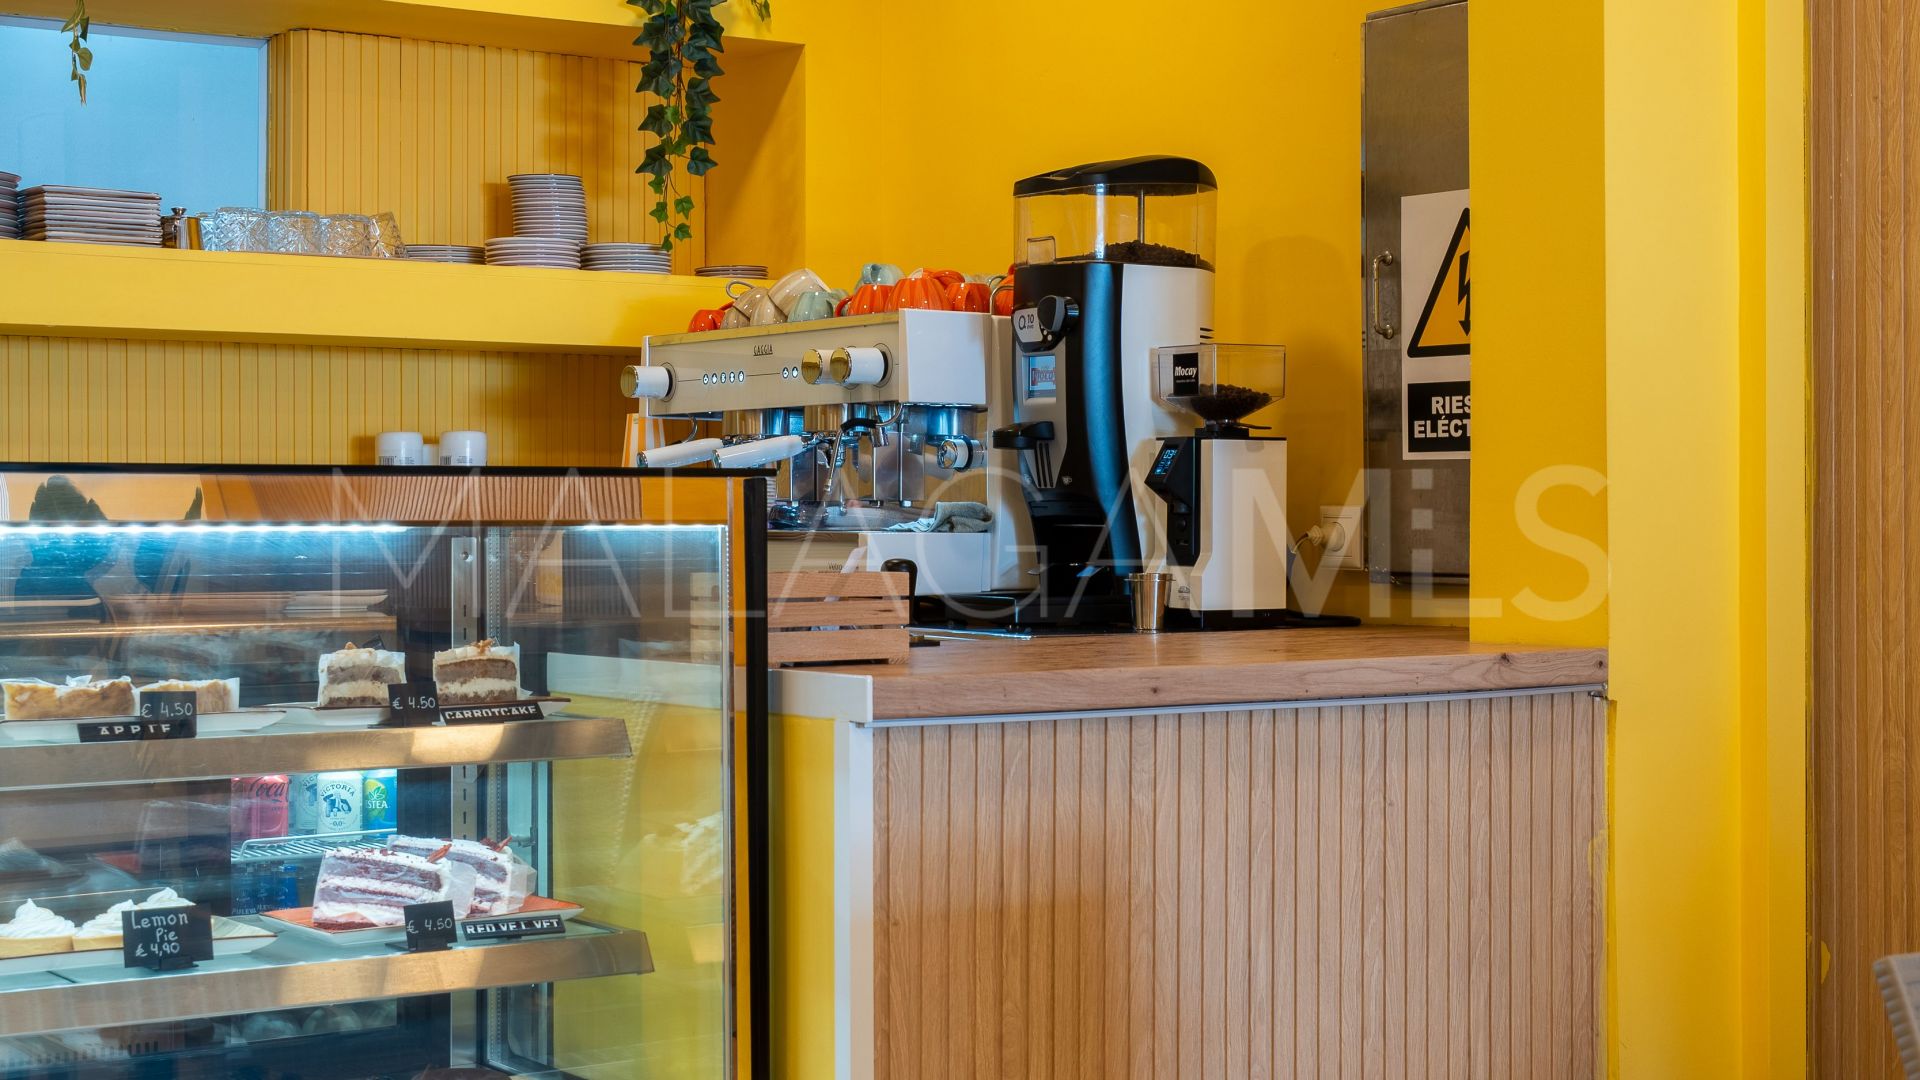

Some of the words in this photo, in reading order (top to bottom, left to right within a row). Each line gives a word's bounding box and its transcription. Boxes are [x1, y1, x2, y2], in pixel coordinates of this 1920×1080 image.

[1174, 366, 1198, 378] Mocay
[1414, 415, 1471, 438] ELÉCT
[141, 703, 153, 718] €
[160, 702, 194, 718] 4.50
[392, 697, 404, 710] €
[408, 696, 436, 709] 4.50
[320, 783, 356, 798] VICTORIA
[131, 911, 189, 929] Lemon
[424, 917, 453, 932] 4.50
[156, 927, 178, 943] Pie
[150, 942, 180, 957] 4,90
